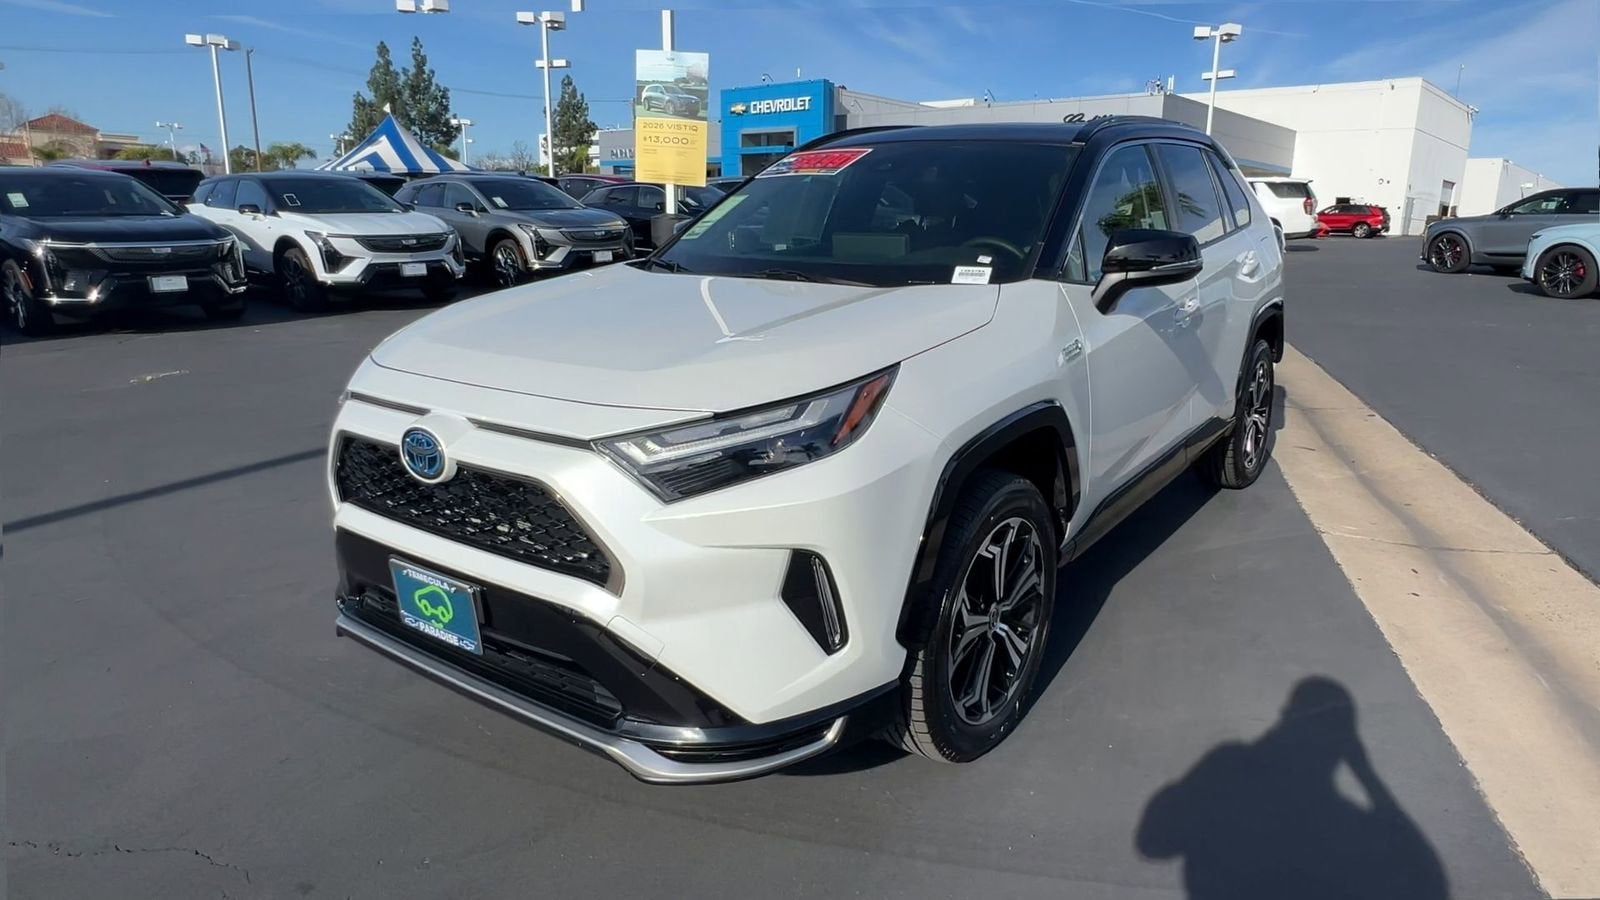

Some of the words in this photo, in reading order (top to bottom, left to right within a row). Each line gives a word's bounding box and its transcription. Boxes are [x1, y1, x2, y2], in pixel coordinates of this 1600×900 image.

[750, 96, 811, 114] CHEVROLET
[667, 123, 699, 132] VISTIQ
[406, 568, 450, 591] TEMECULA
[419, 621, 460, 646] PARADISE
